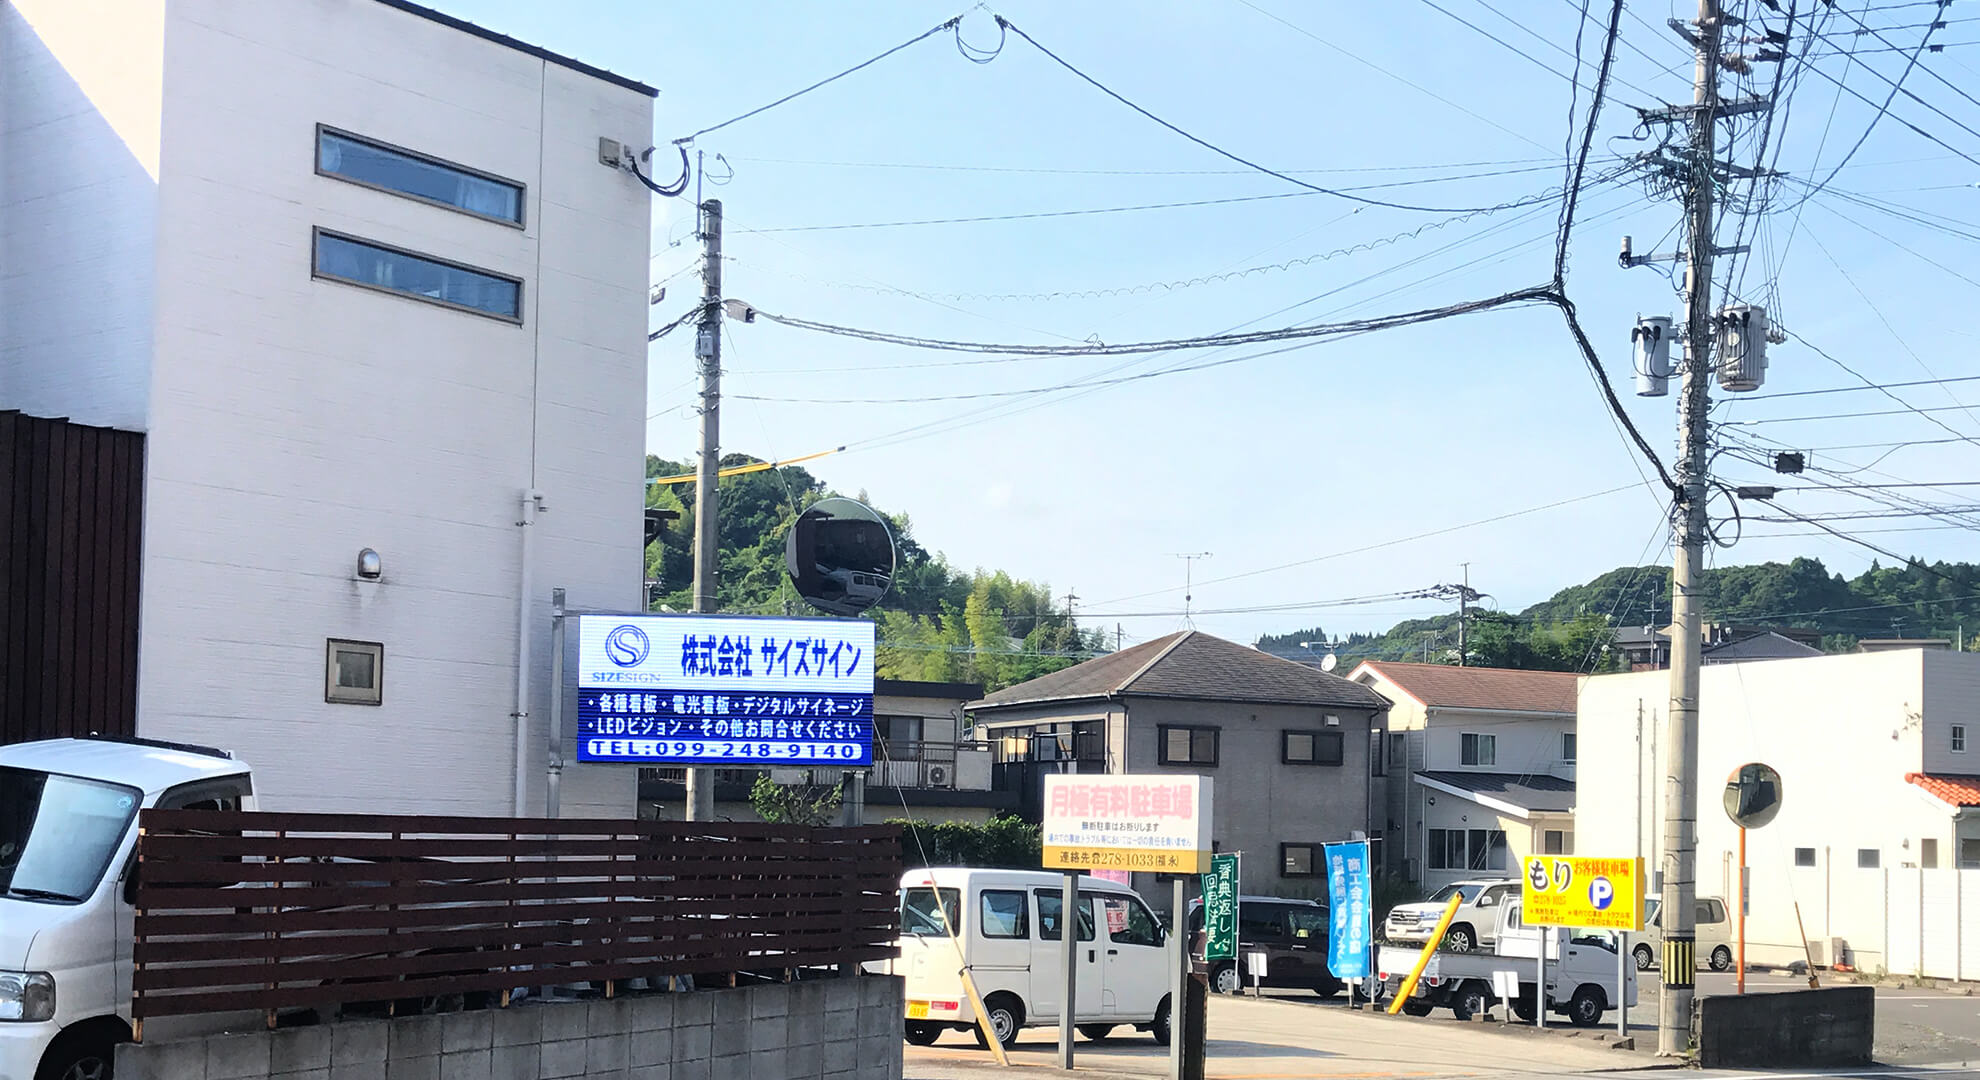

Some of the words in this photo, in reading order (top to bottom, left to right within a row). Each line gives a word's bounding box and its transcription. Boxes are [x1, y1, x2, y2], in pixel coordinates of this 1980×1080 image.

[681, 634, 752, 678] 株式会社
[761, 637, 862, 679] サイズサイン
[592, 671, 661, 683] SIZESIGN
[591, 740, 855, 759] TEL:099-248-9140
[1051, 784, 1192, 820] 月極有料駐車場
[1530, 860, 1571, 892] もり
[1574, 860, 1629, 877] お客様駐車場
